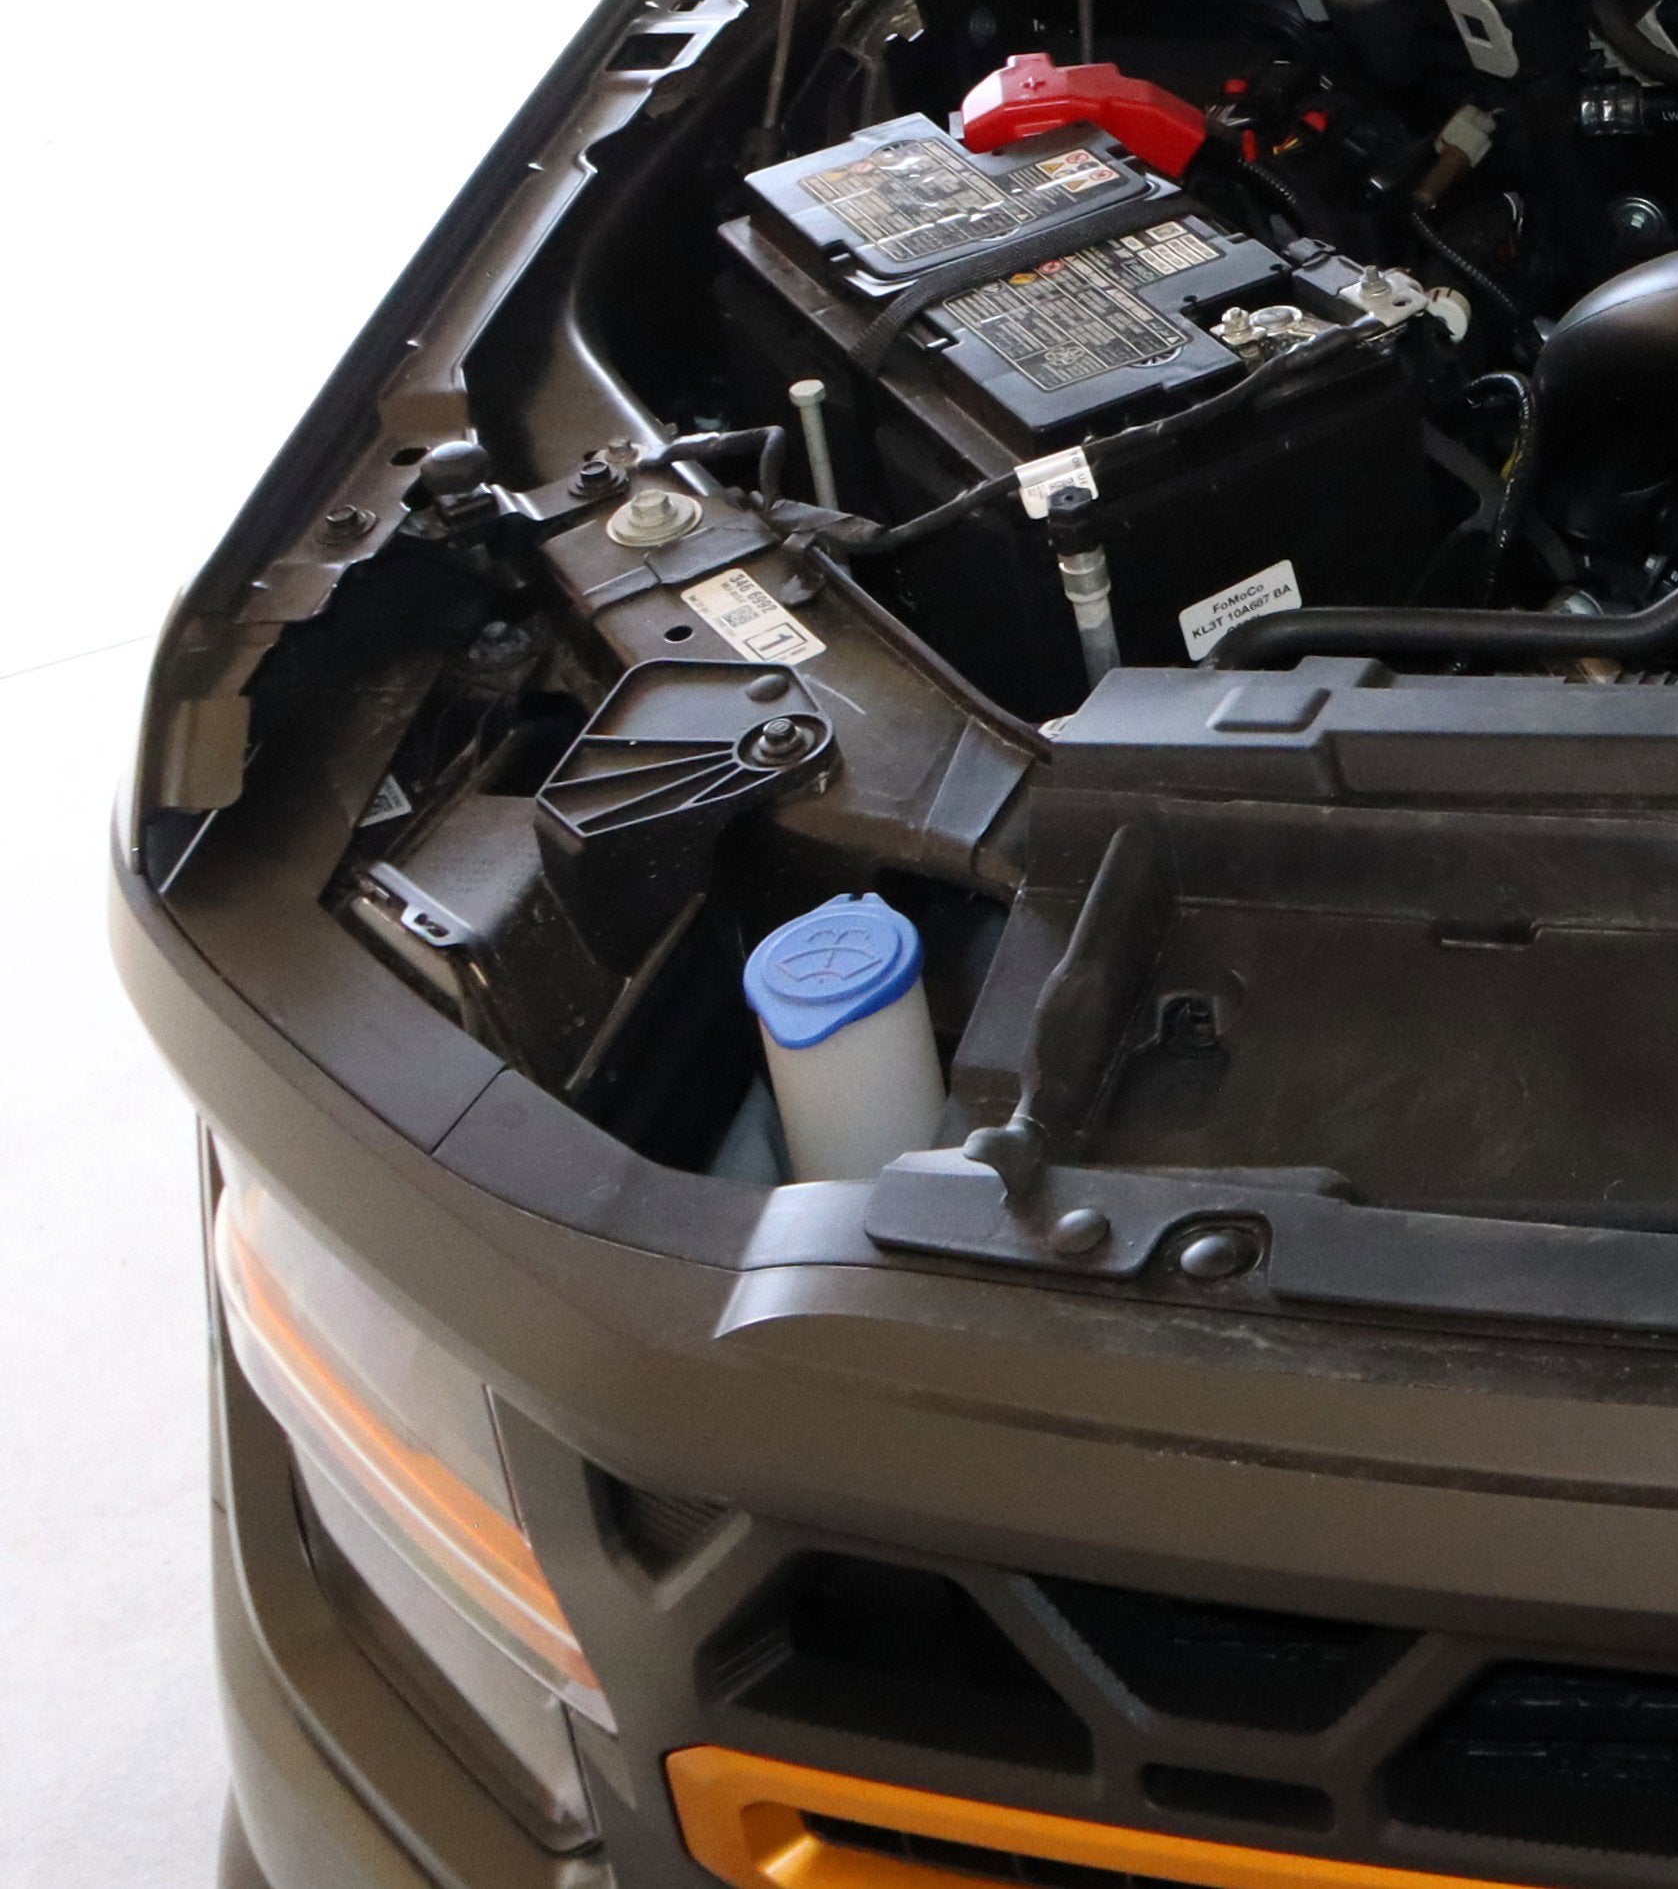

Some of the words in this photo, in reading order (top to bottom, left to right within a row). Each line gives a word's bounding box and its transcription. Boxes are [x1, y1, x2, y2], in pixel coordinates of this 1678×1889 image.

[728, 573, 753, 593] 346
[748, 590, 778, 614] 6992
[1191, 614, 1224, 640] KL3T
[1271, 583, 1293, 605] BA
[1212, 581, 1266, 615] FoMoCo
[757, 632, 795, 653] 1
